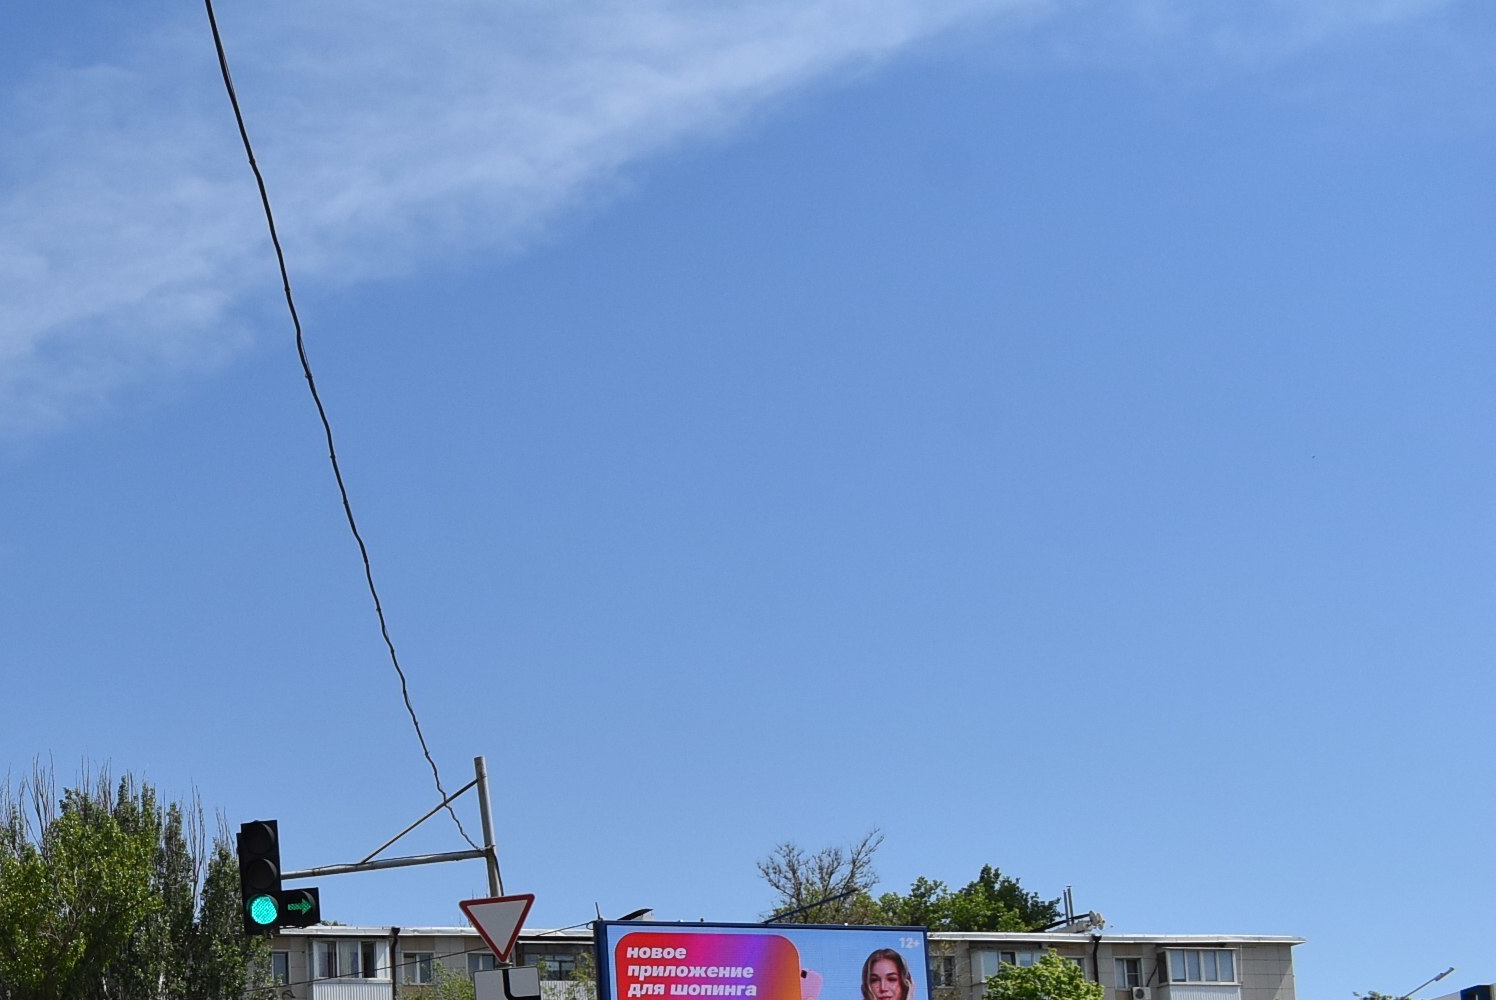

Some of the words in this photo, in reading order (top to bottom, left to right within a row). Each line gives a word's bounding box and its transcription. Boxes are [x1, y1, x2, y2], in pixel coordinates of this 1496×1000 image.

[899, 937, 920, 948] 12+
[627, 947, 687, 958] новое
[627, 965, 754, 981] приложение
[628, 984, 665, 997] для
[670, 984, 757, 996] шопинга
